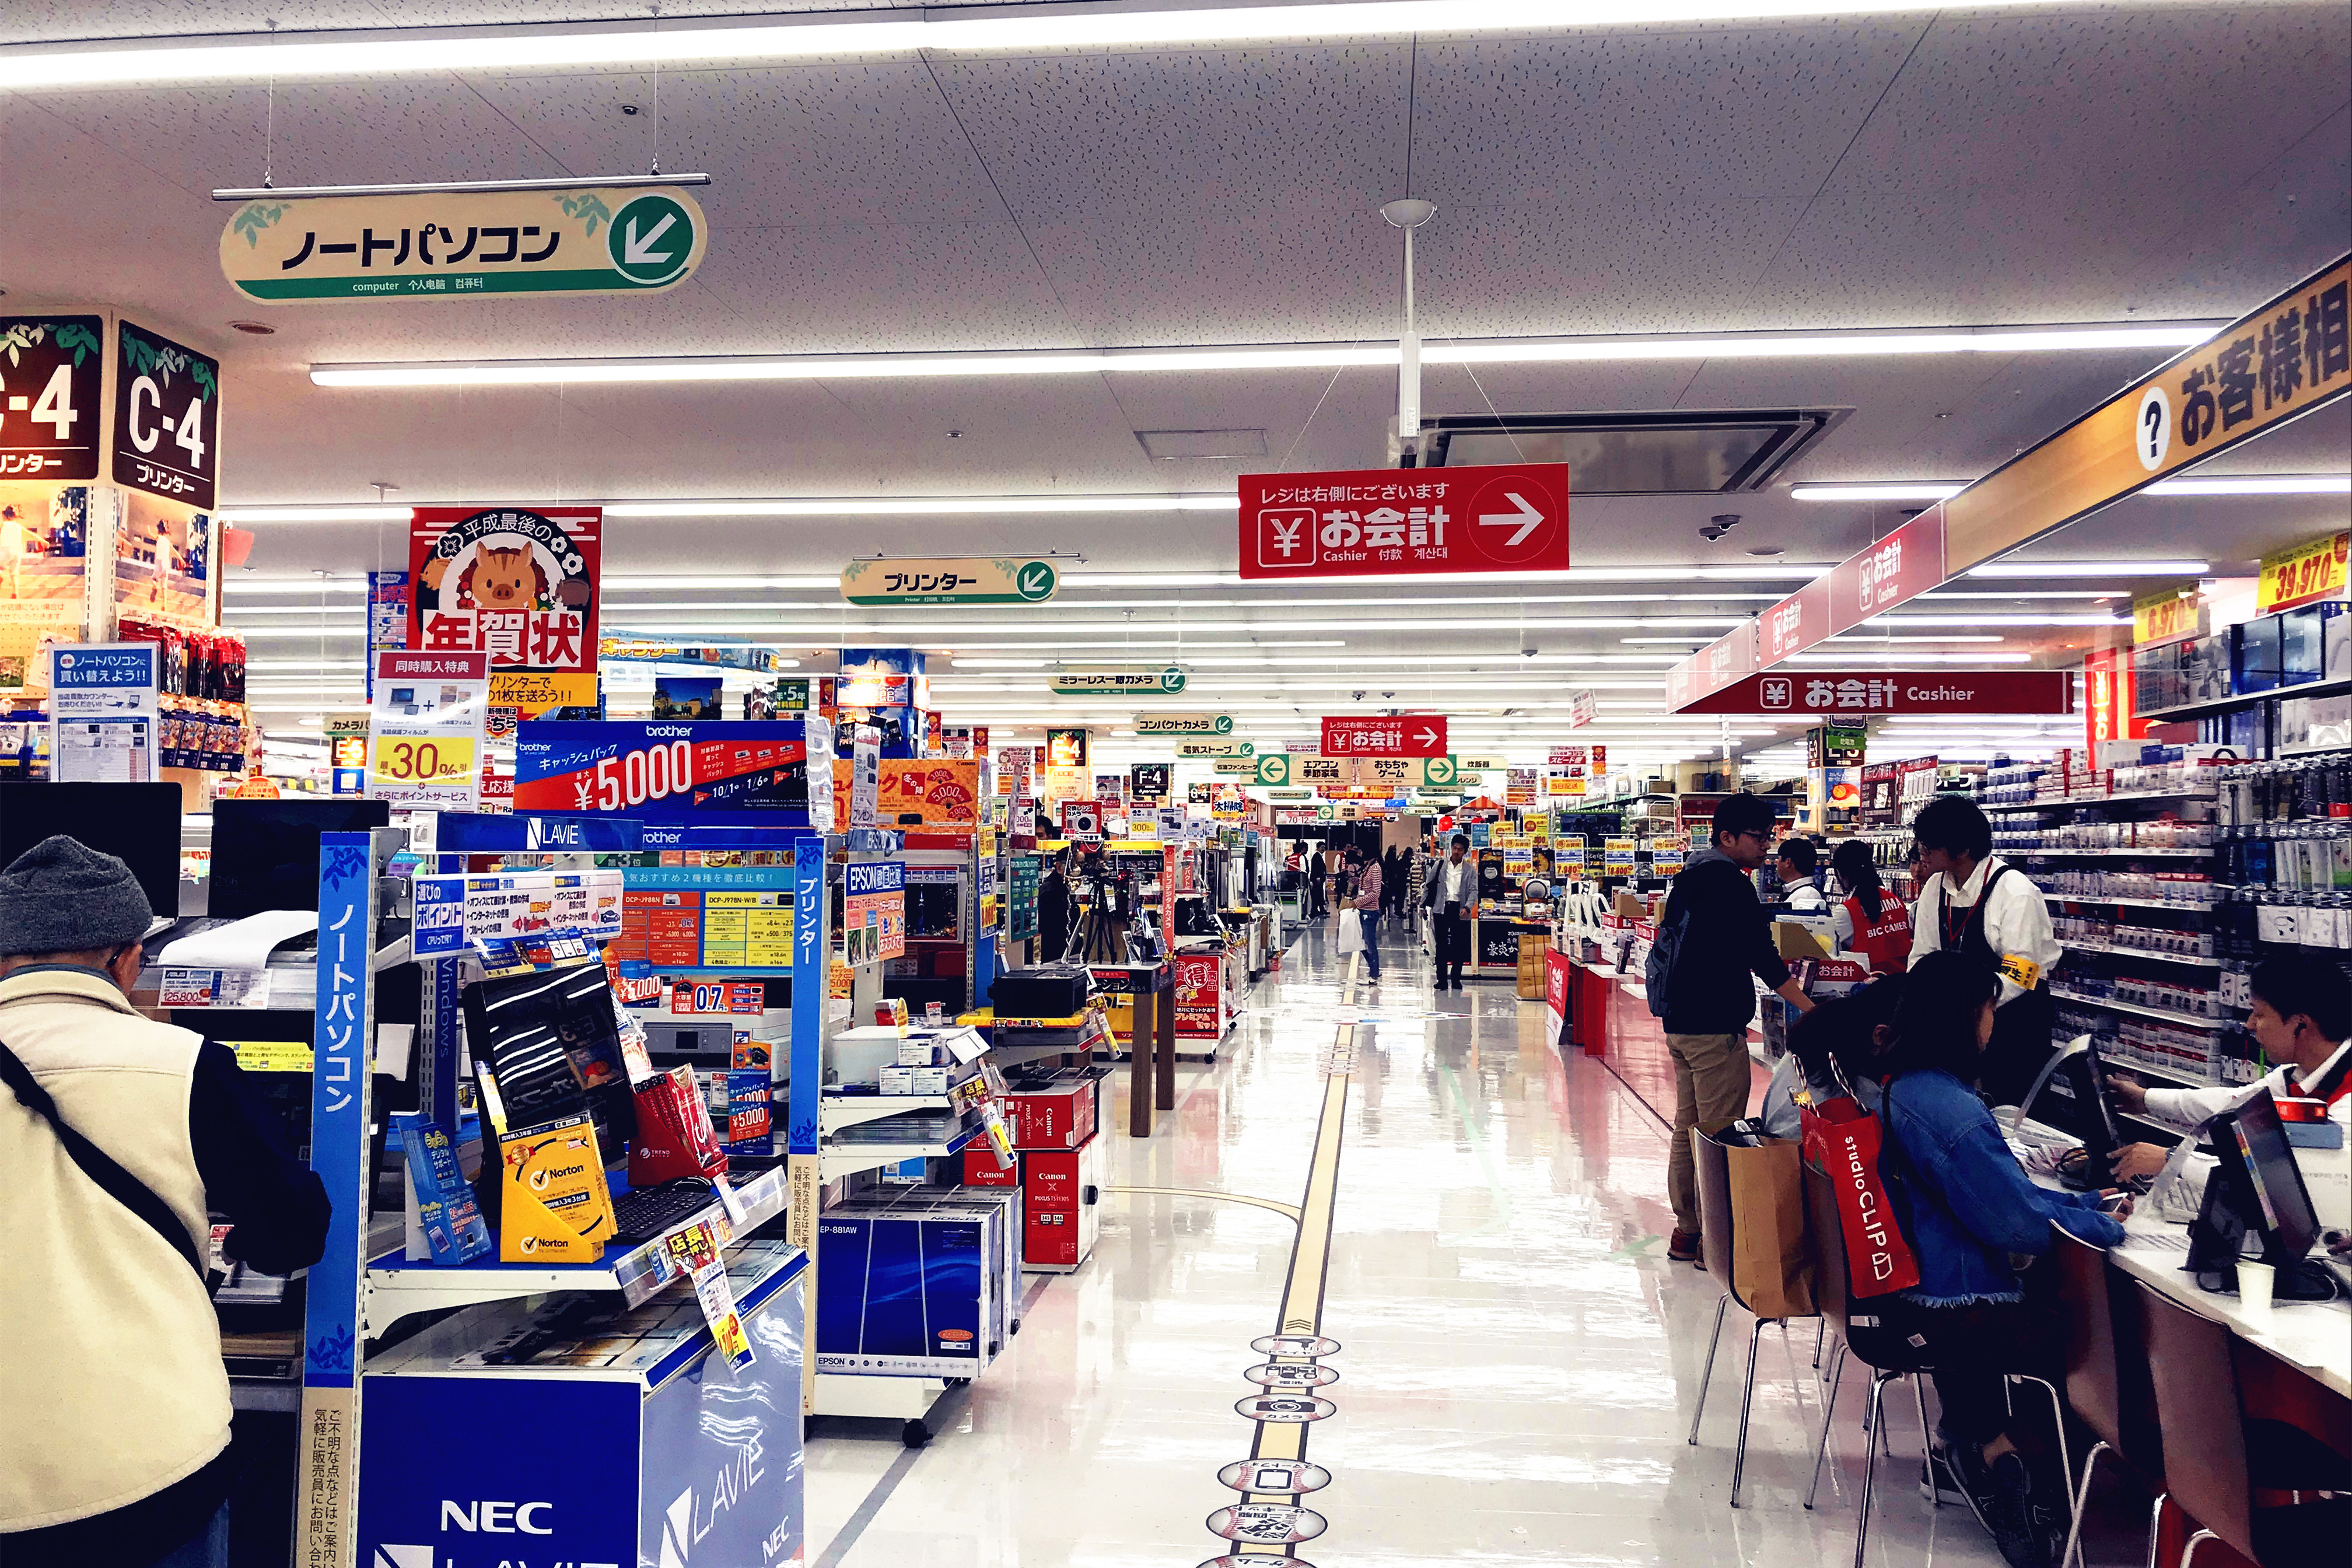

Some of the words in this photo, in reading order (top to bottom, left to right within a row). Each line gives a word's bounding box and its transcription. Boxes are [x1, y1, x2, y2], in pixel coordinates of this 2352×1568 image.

[282, 223, 561, 271] ノートパソコン
[352, 280, 400, 292] computer
[455, 277, 484, 289] 컴퓨터
[2181, 280, 2350, 447] お客様相
[0, 365, 78, 440] -4
[129, 375, 205, 469] C-4
[136, 464, 195, 494] プリンター
[1261, 482, 1450, 504] レジは右側にございます
[463, 513, 554, 542] 平成最後の
[1320, 505, 1450, 548] お会計
[1323, 550, 1367, 562] Cashier
[1378, 548, 1402, 561] 付款
[1414, 547, 1448, 560] 계산대
[1874, 538, 1902, 584] お会計
[884, 572, 977, 592] プリンター
[1877, 582, 1898, 604] Cashier
[1782, 598, 1802, 633] お会計
[426, 610, 582, 665] 年賀状
[395, 660, 469, 673] 同時購入特典
[60, 670, 146, 683] 買い替えよう!!
[1058, 675, 1154, 685] ミラーレス一眼カメラ
[1805, 678, 1898, 708] お会計
[1907, 686, 1975, 701] Cashier
[646, 726, 692, 737] brother
[1139, 720, 1209, 730] コンパクトカメラ
[1353, 730, 1403, 747] お会計
[519, 743, 552, 751] brother
[1183, 746, 1232, 754] 電気ストーブ
[539, 744, 617, 771] キャッシュバック
[1303, 761, 1338, 769] エアコン
[1374, 760, 1409, 769] おもちゃ
[573, 740, 692, 811] ¥5,000
[576, 771, 590, 780] 最大
[1139, 771, 1161, 784] F-4
[1303, 769, 1339, 778] 季節家電
[1378, 769, 1405, 778] ゲーム
[903, 774, 923, 794] 冬の陣
[374, 791, 467, 802] さらにポイントサービス
[542, 824, 579, 845] LAVIE
[850, 866, 876, 891] EPSON
[417, 883, 441, 900] 選びの
[416, 905, 461, 926] ポイント
[799, 877, 818, 965] プリンター
[426, 935, 453, 945] CPUって何?
[1866, 928, 1883, 939] BIC
[1819, 965, 1855, 977] お会計
[324, 904, 355, 1112] ノートパソコン
[1175, 1013, 1210, 1021] プレミアム
[965, 1078, 985, 1095] 店長
[433, 1159, 452, 1169] サポート
[549, 1164, 584, 1180] Norton
[977, 1171, 1005, 1179] Canon
[820, 1226, 858, 1234] EP-881AW
[538, 1238, 568, 1248] Norton
[668, 1224, 704, 1253] 店長
[682, 1241, 709, 1256] 一押し
[818, 1357, 846, 1366] EPSON
[1237, 1461, 1315, 1470] スマートフォン
[1230, 1506, 1307, 1514] サーキット
[441, 1500, 552, 1535] NEC
[762, 1516, 789, 1565] NEC
[1237, 1558, 1284, 1567] ゲーム
